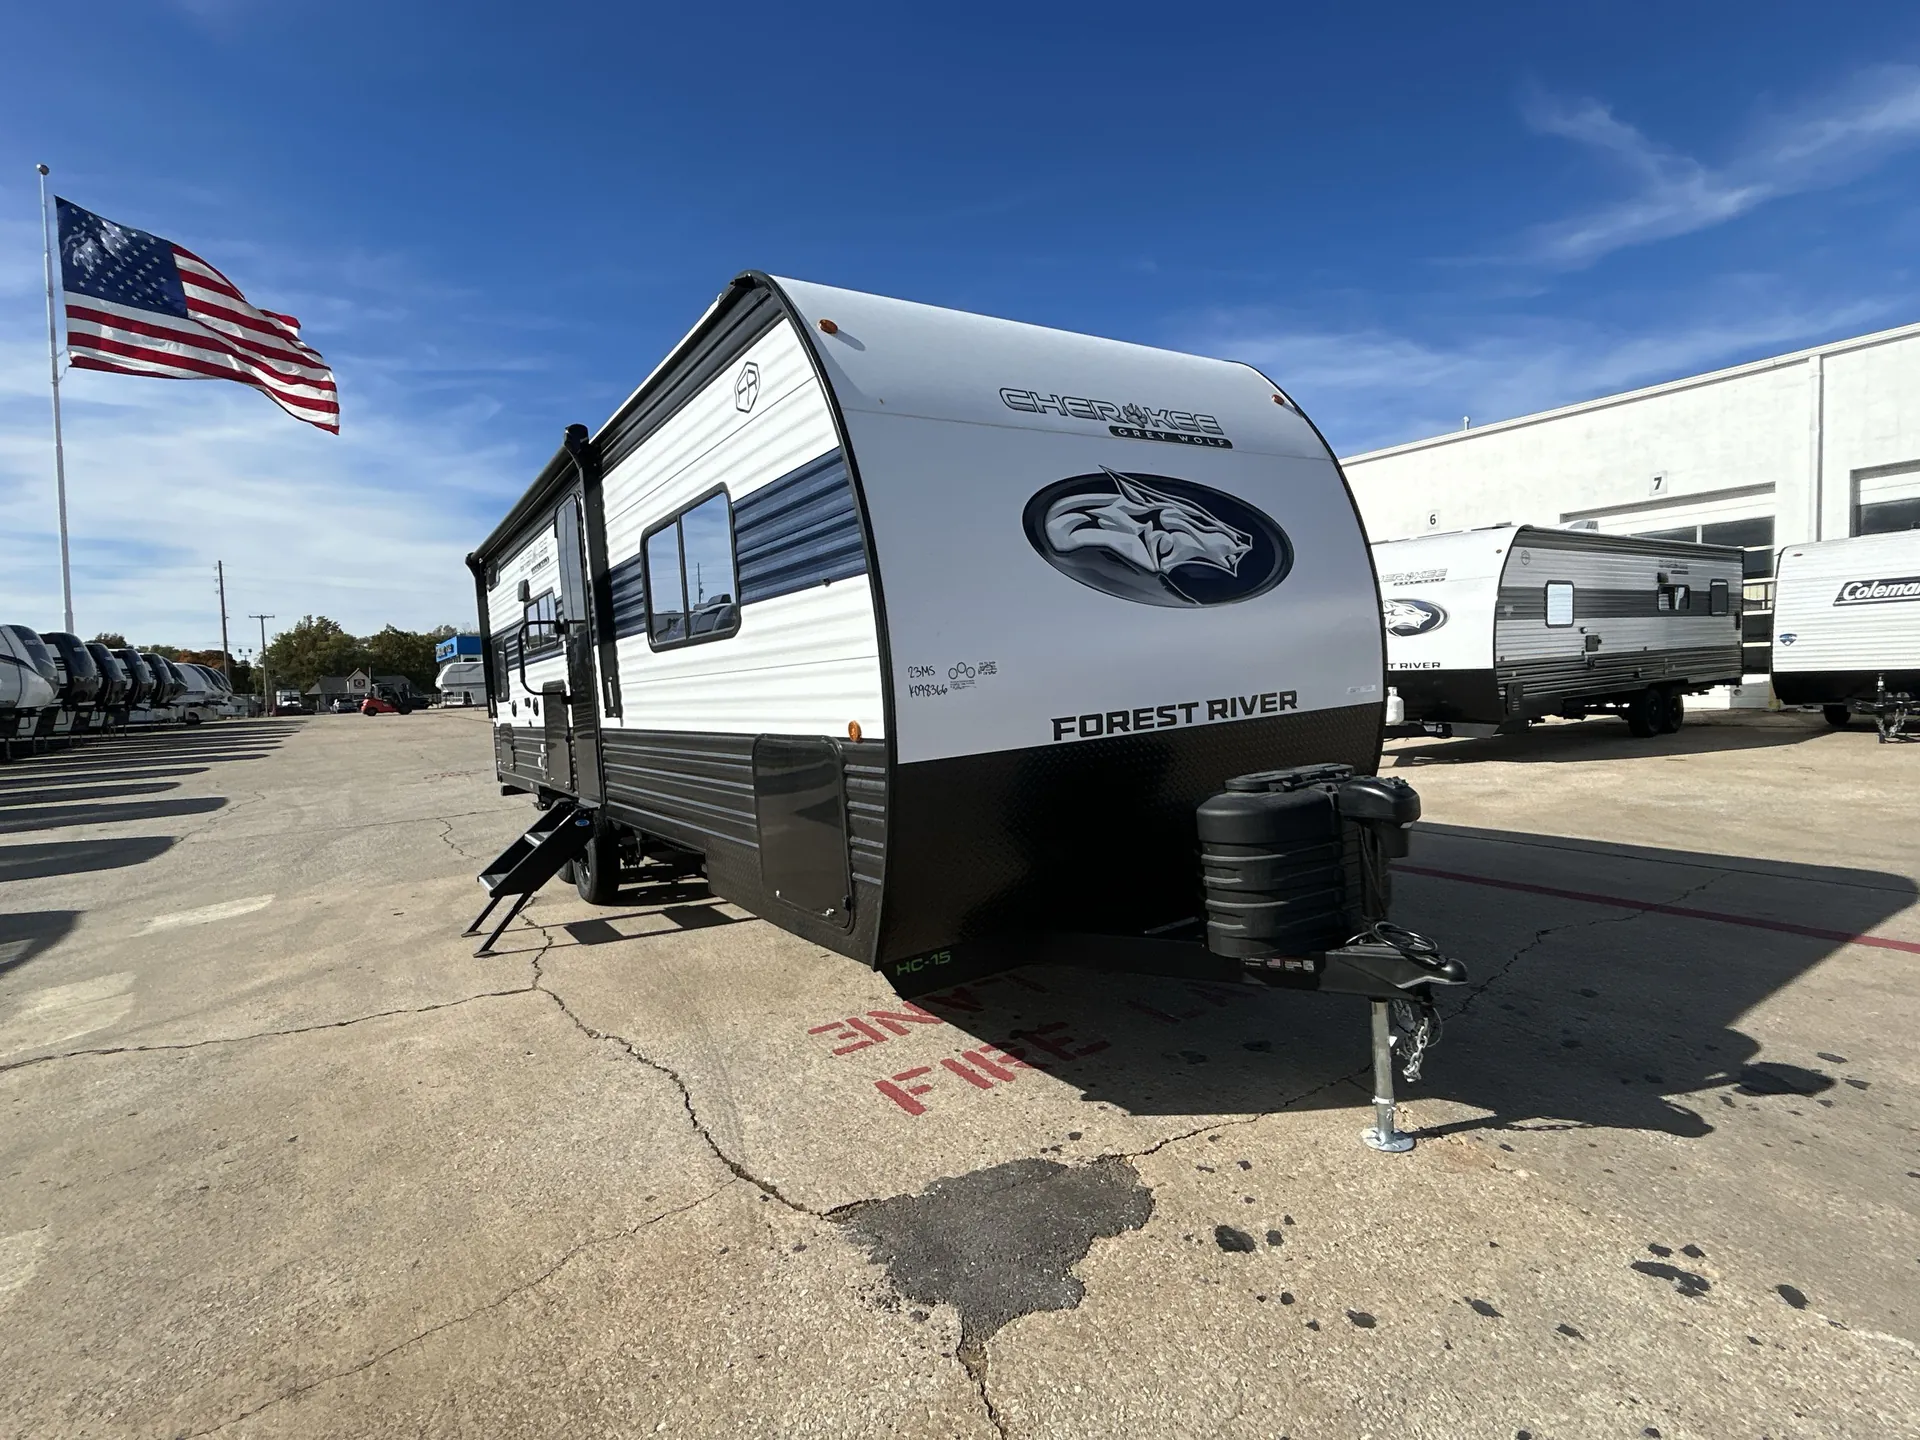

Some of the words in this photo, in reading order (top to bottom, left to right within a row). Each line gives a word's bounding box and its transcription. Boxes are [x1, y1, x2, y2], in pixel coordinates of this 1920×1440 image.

[1118, 427, 1167, 440] GREY
[1178, 434, 1225, 447] WOLF
[1653, 476, 1663, 491] 7
[1429, 513, 1437, 526] 6
[1399, 661, 1441, 669] RIVER
[1050, 701, 1199, 742] FOREST
[1206, 689, 1299, 721] RIVER
[896, 950, 951, 977] HC-15
[873, 1021, 1112, 1117] FIRE
